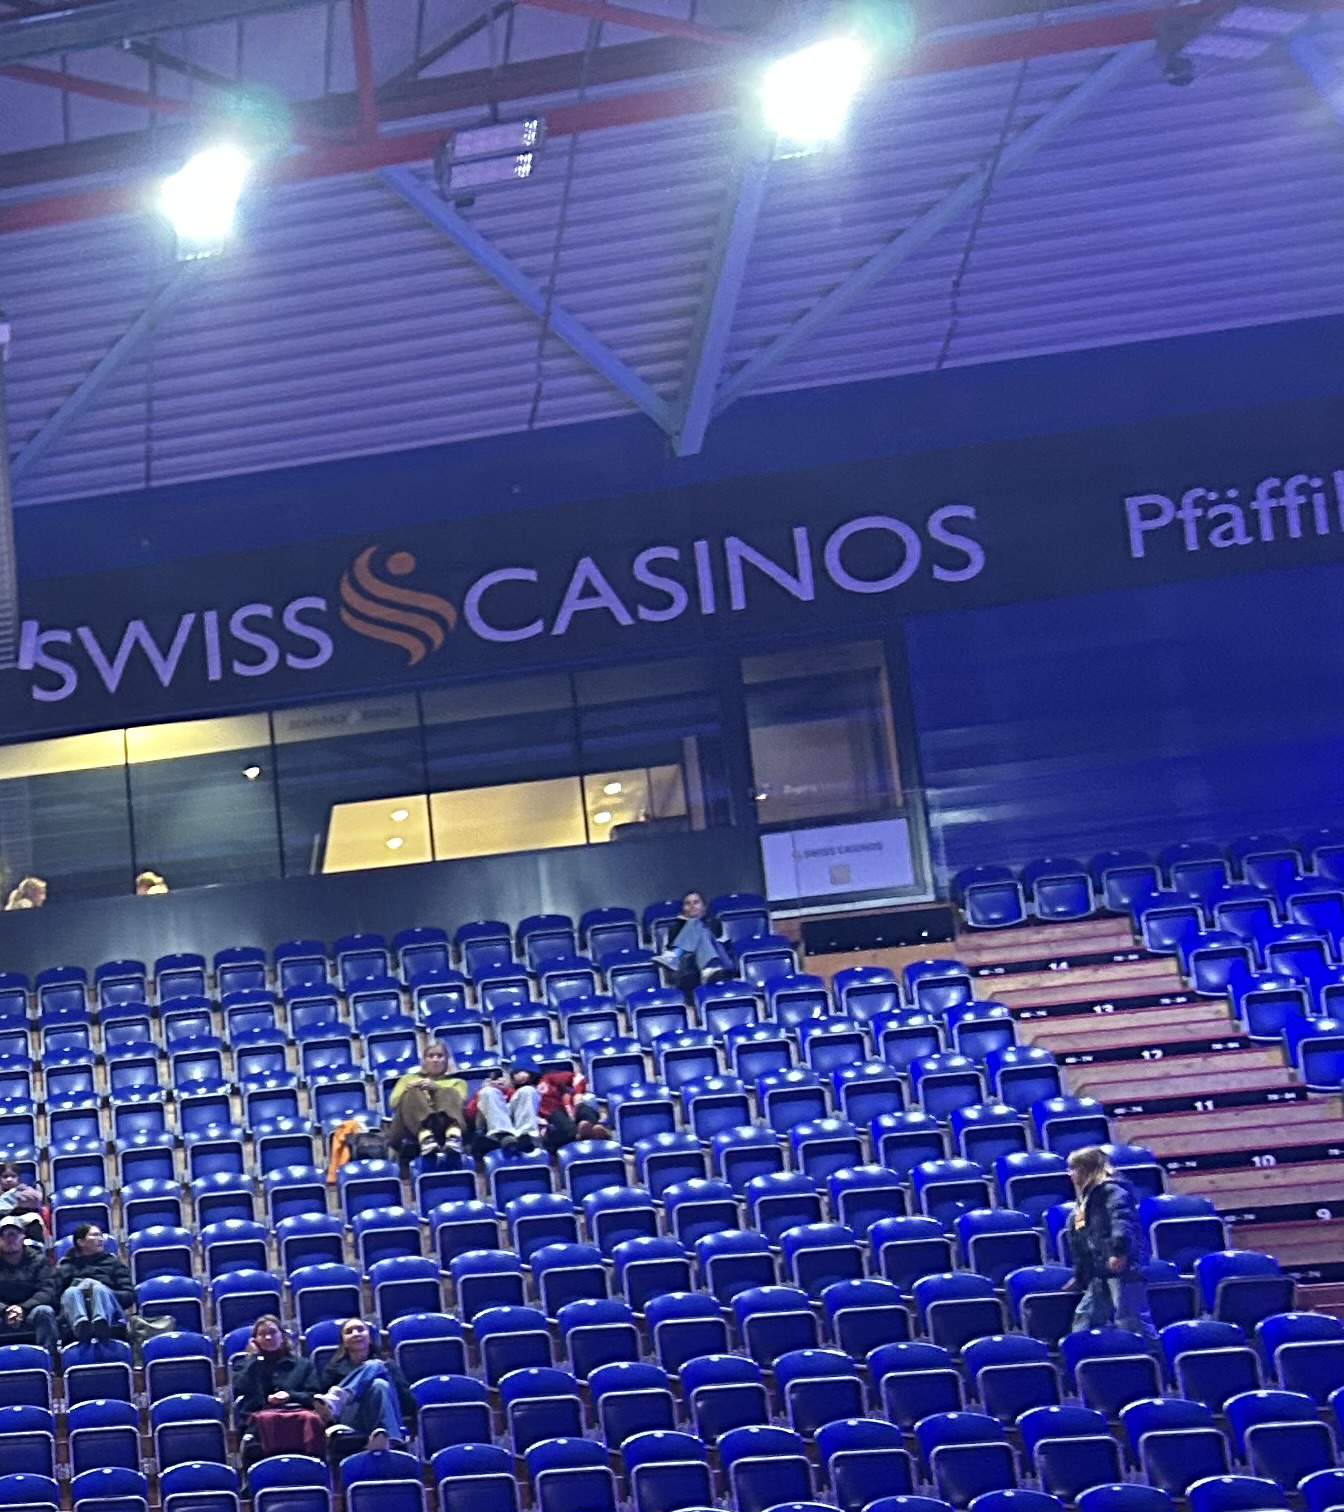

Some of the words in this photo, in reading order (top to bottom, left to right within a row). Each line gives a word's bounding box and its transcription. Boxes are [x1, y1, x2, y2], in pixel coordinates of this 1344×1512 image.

[1124, 469, 1344, 558] Pfäffi
[30, 596, 334, 702] SWISS
[463, 503, 987, 644] CASINOS
[1250, 1154, 1277, 1168] 10
[1315, 1208, 1332, 1221] 9
